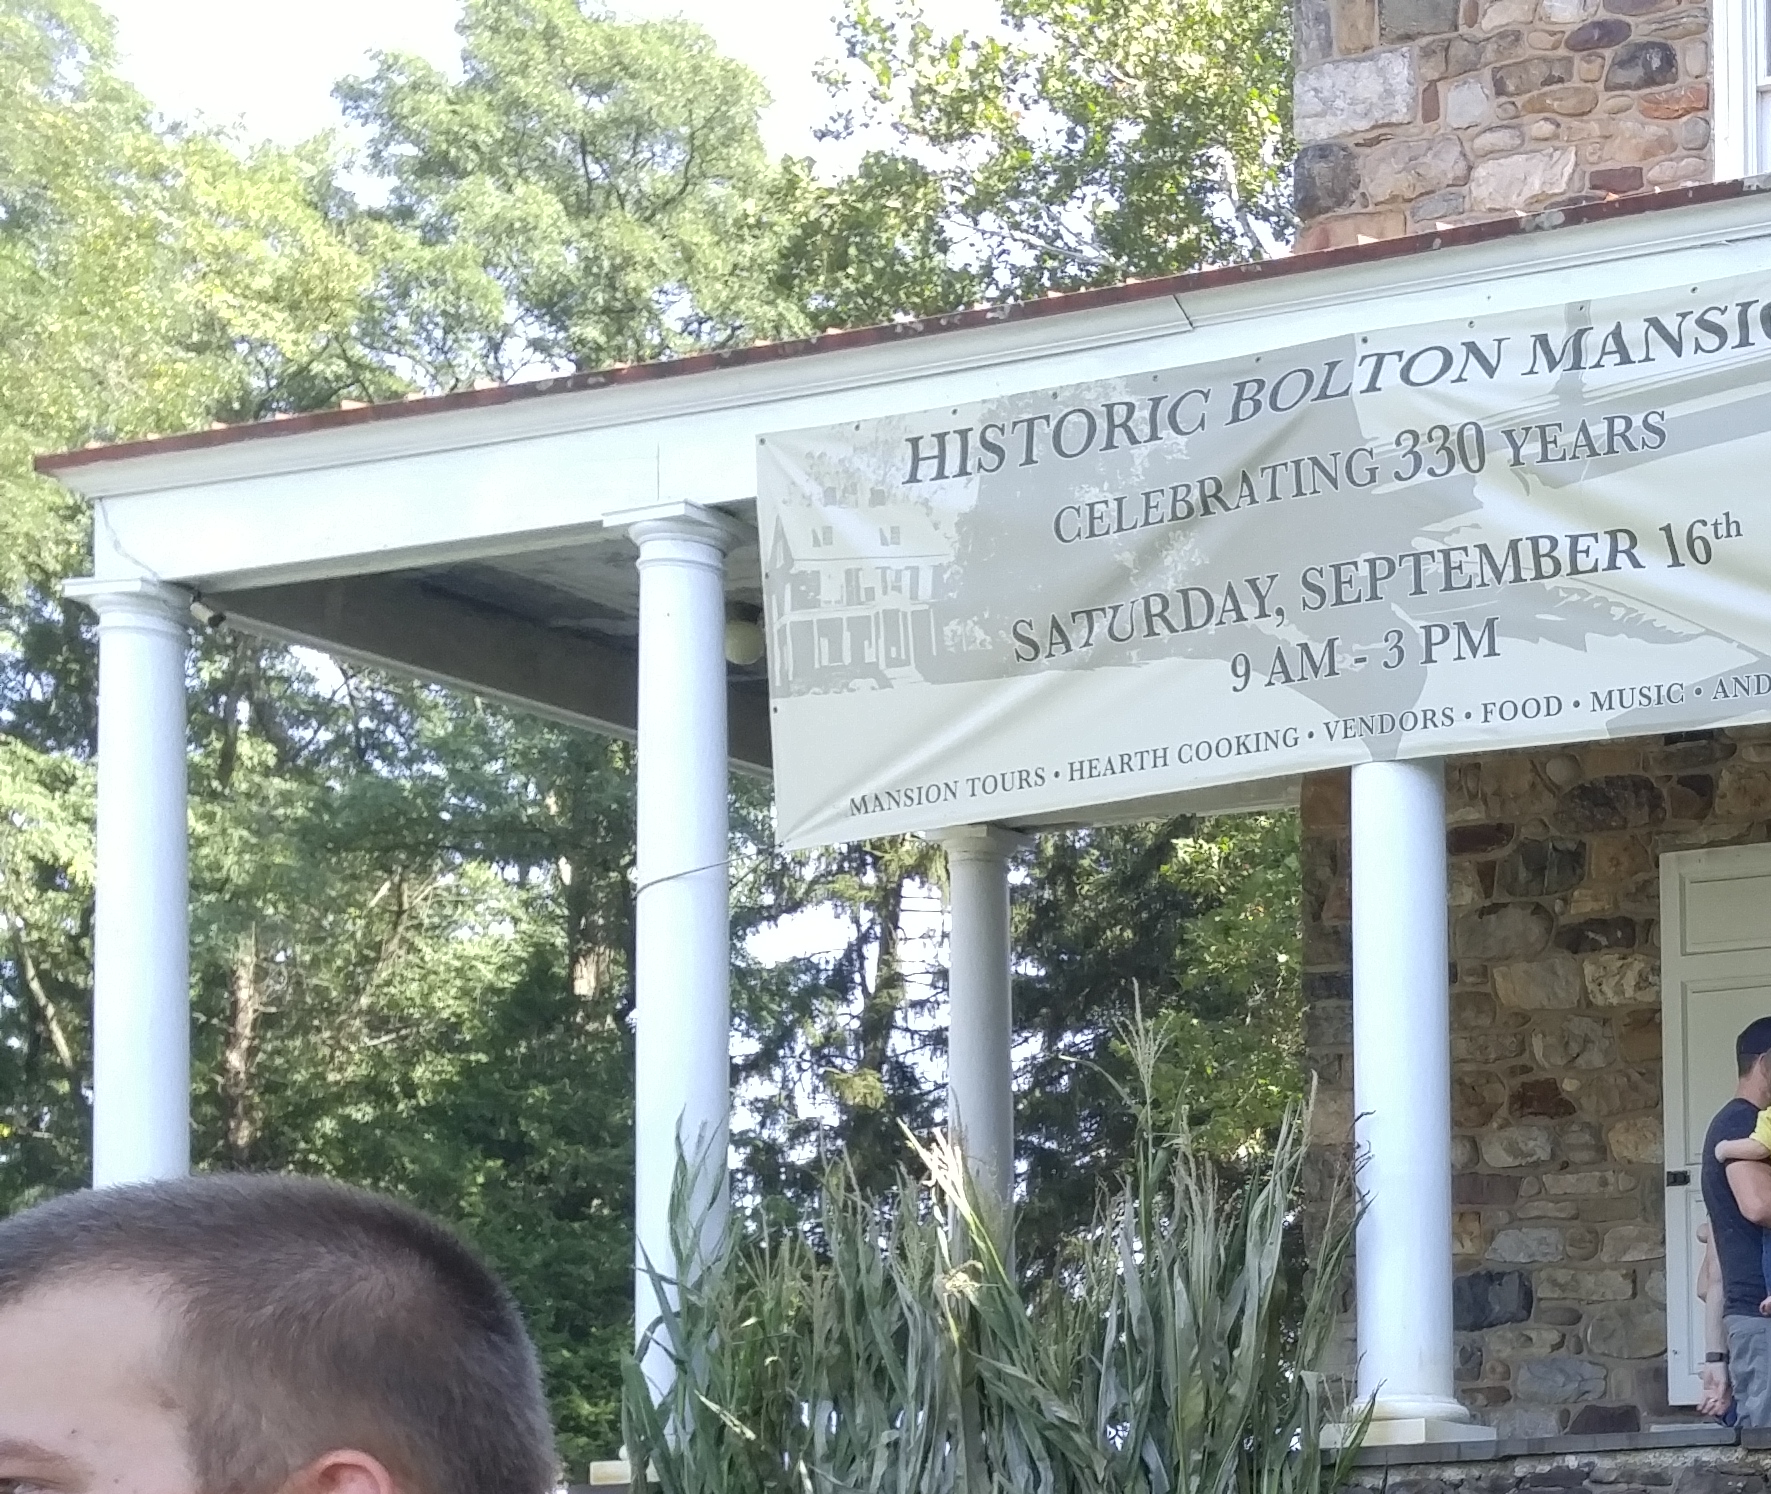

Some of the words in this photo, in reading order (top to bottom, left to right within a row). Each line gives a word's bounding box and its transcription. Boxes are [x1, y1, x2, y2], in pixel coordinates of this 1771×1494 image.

[902, 389, 1212, 485] HISTORIC
[1223, 337, 1511, 427] BOLTON
[1053, 447, 1380, 544] CELEBRATING
[1393, 420, 1486, 483] 330
[1501, 410, 1668, 469] YEARS
[1011, 573, 1286, 663] SATURDAY,
[1300, 527, 1645, 612] SEPTEMBER
[1658, 510, 1744, 569] 16th
[1230, 652, 1252, 693] 9
[1264, 637, 1342, 688] AM
[1382, 629, 1404, 672] 3
[1418, 616, 1502, 666] PM
[849, 780, 960, 817] MANSION
[966, 766, 1047, 798] TOURS
[1067, 746, 1171, 782] HEARTH
[1177, 726, 1300, 765] COOKING
[1323, 705, 1455, 743] VENDORS
[1480, 695, 1563, 724] FOOD
[1589, 682, 1686, 713] MUSIC
